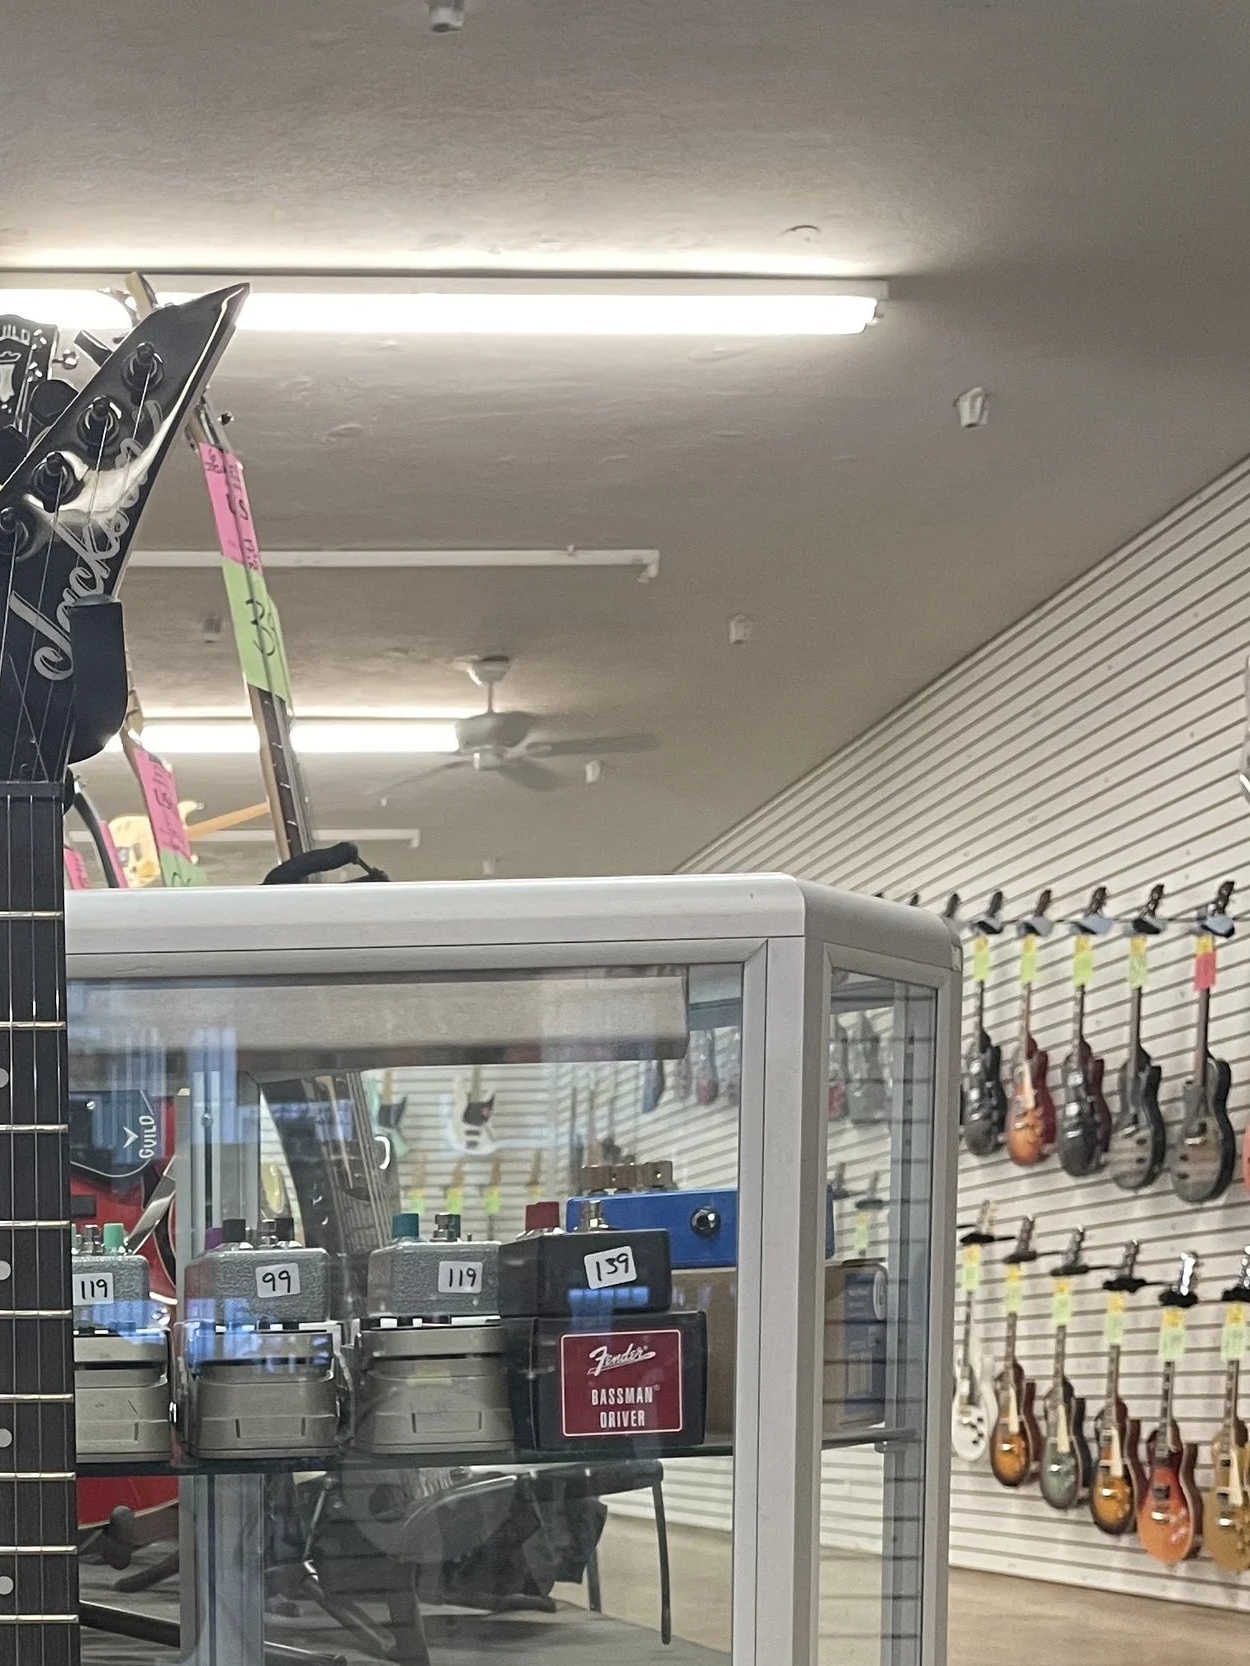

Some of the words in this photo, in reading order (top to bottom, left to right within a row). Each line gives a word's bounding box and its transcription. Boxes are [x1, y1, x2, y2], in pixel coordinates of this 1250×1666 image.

[138, 1115, 157, 1159] GUILD
[449, 1267, 477, 1288] 119
[595, 1253, 630, 1282] 139
[81, 1278, 108, 1300] 119
[261, 1269, 292, 1294] 99
[587, 1343, 656, 1377] Fender
[591, 1386, 654, 1407] BASSMAN
[599, 1410, 646, 1429] DRIVER
